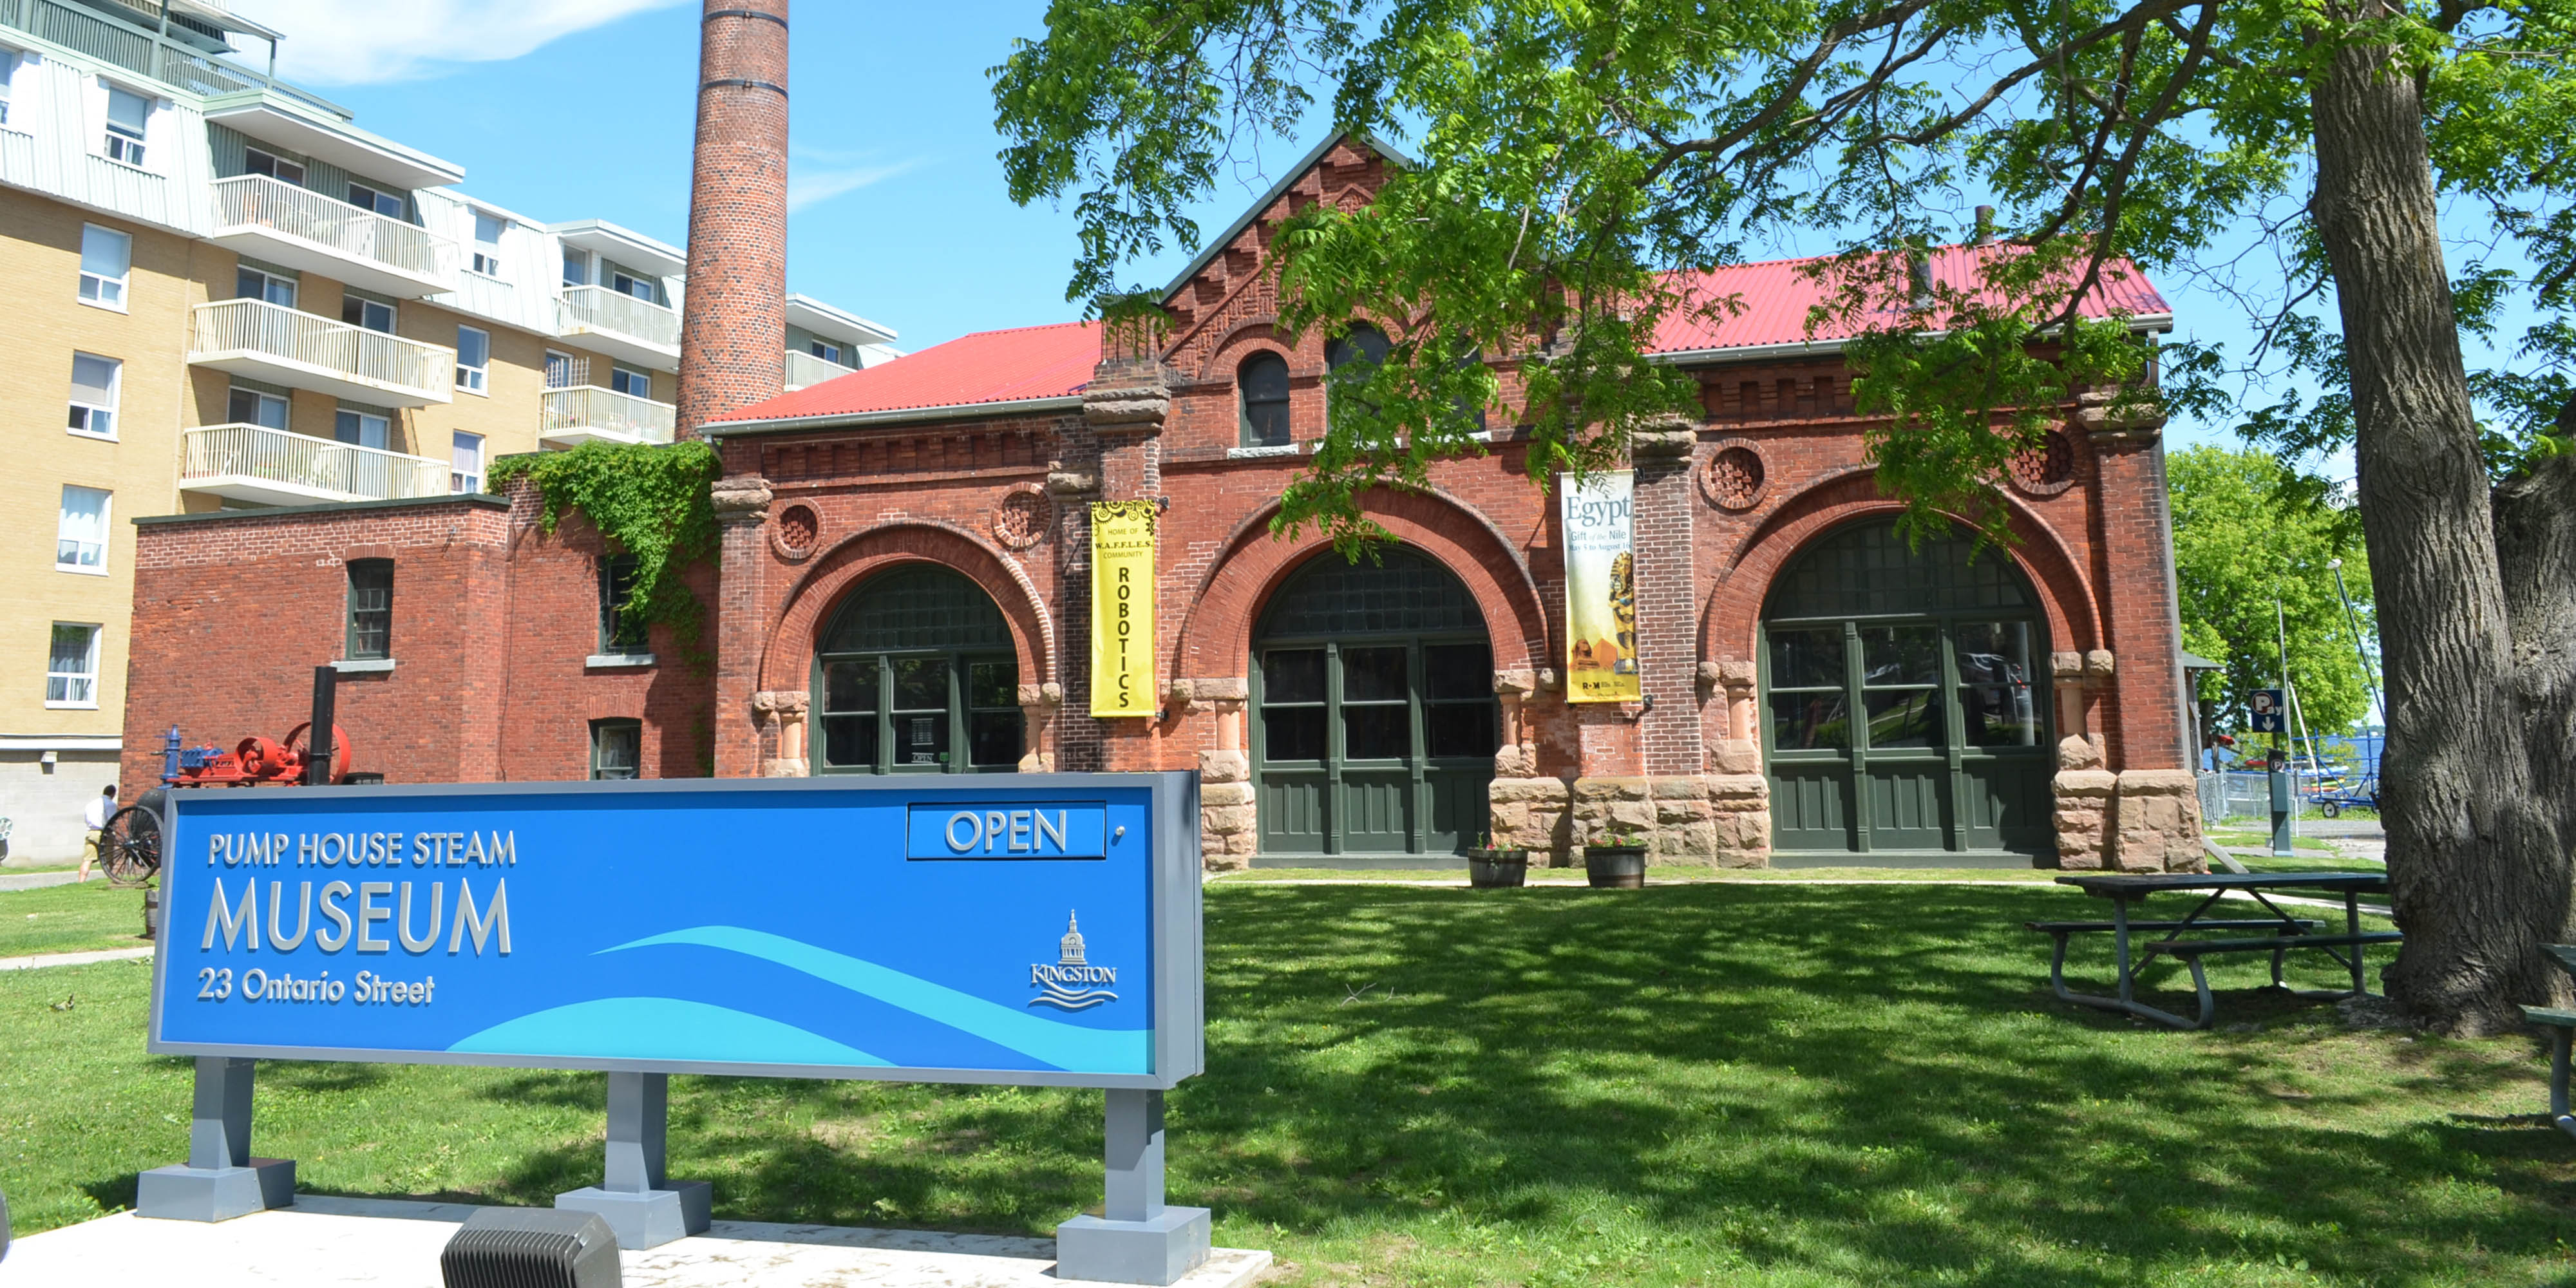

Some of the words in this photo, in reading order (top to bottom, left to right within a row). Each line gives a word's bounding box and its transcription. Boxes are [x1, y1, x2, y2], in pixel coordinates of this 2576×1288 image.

[1566, 496, 1631, 527] Egypt
[1571, 531, 1587, 541] Gift
[1609, 529, 1627, 540] Nile
[1103, 551, 1144, 559] COMMUNITY
[1117, 567, 1130, 708] ROBOTICS
[2255, 696, 2282, 715] Pay
[2274, 761, 2281, 770] P
[945, 809, 1066, 851] OPEN
[207, 832, 289, 866] PUMP
[297, 832, 403, 865] HOUSE
[412, 829, 516, 865] STEAM
[201, 876, 511, 956] MUSEUM
[197, 967, 232, 1000] 23
[242, 968, 345, 1003] Ontario
[354, 970, 435, 1005] Street
[1030, 963, 1117, 985] KINGSTON
